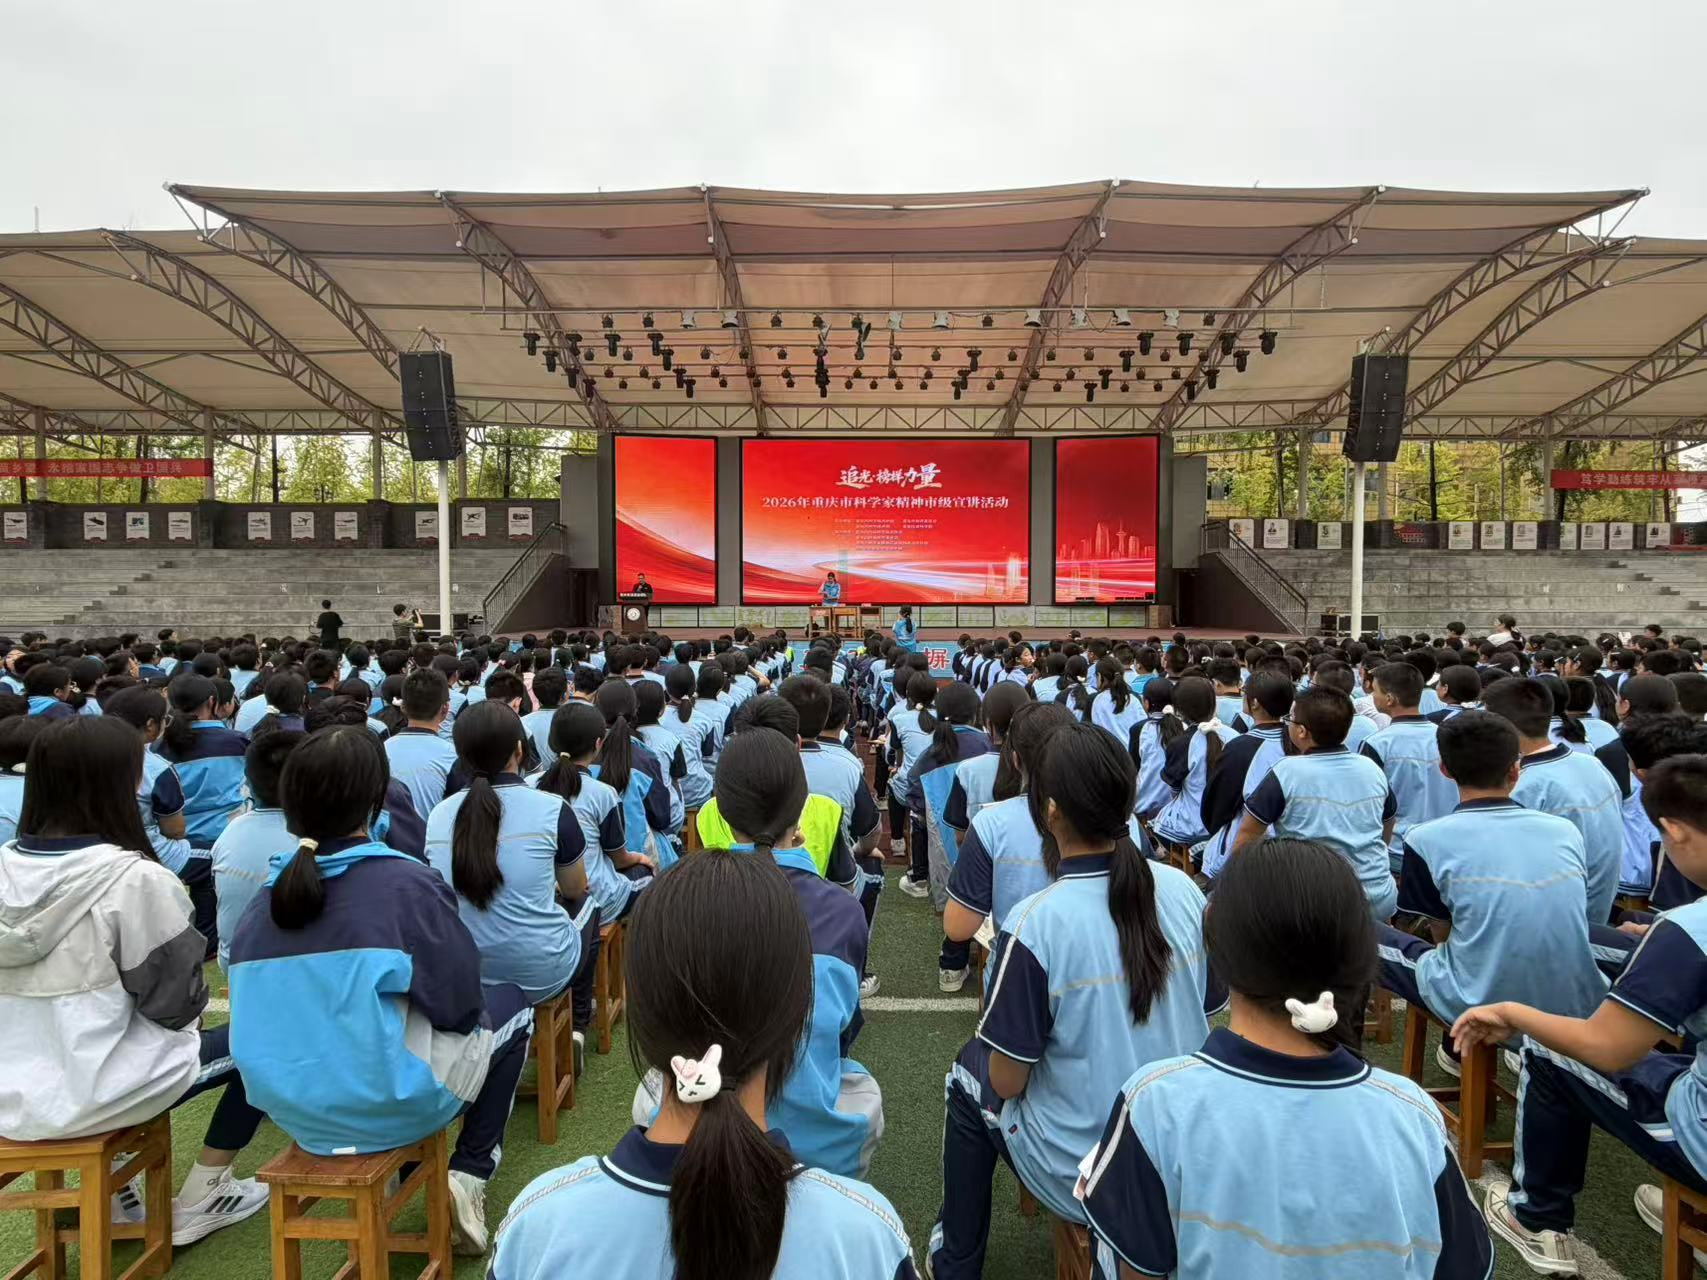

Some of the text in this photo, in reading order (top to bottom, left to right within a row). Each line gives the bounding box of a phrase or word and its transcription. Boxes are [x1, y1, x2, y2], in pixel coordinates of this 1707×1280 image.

[762, 496, 1009, 509] 2026年重庆市科学家精神市级宣讲活动
